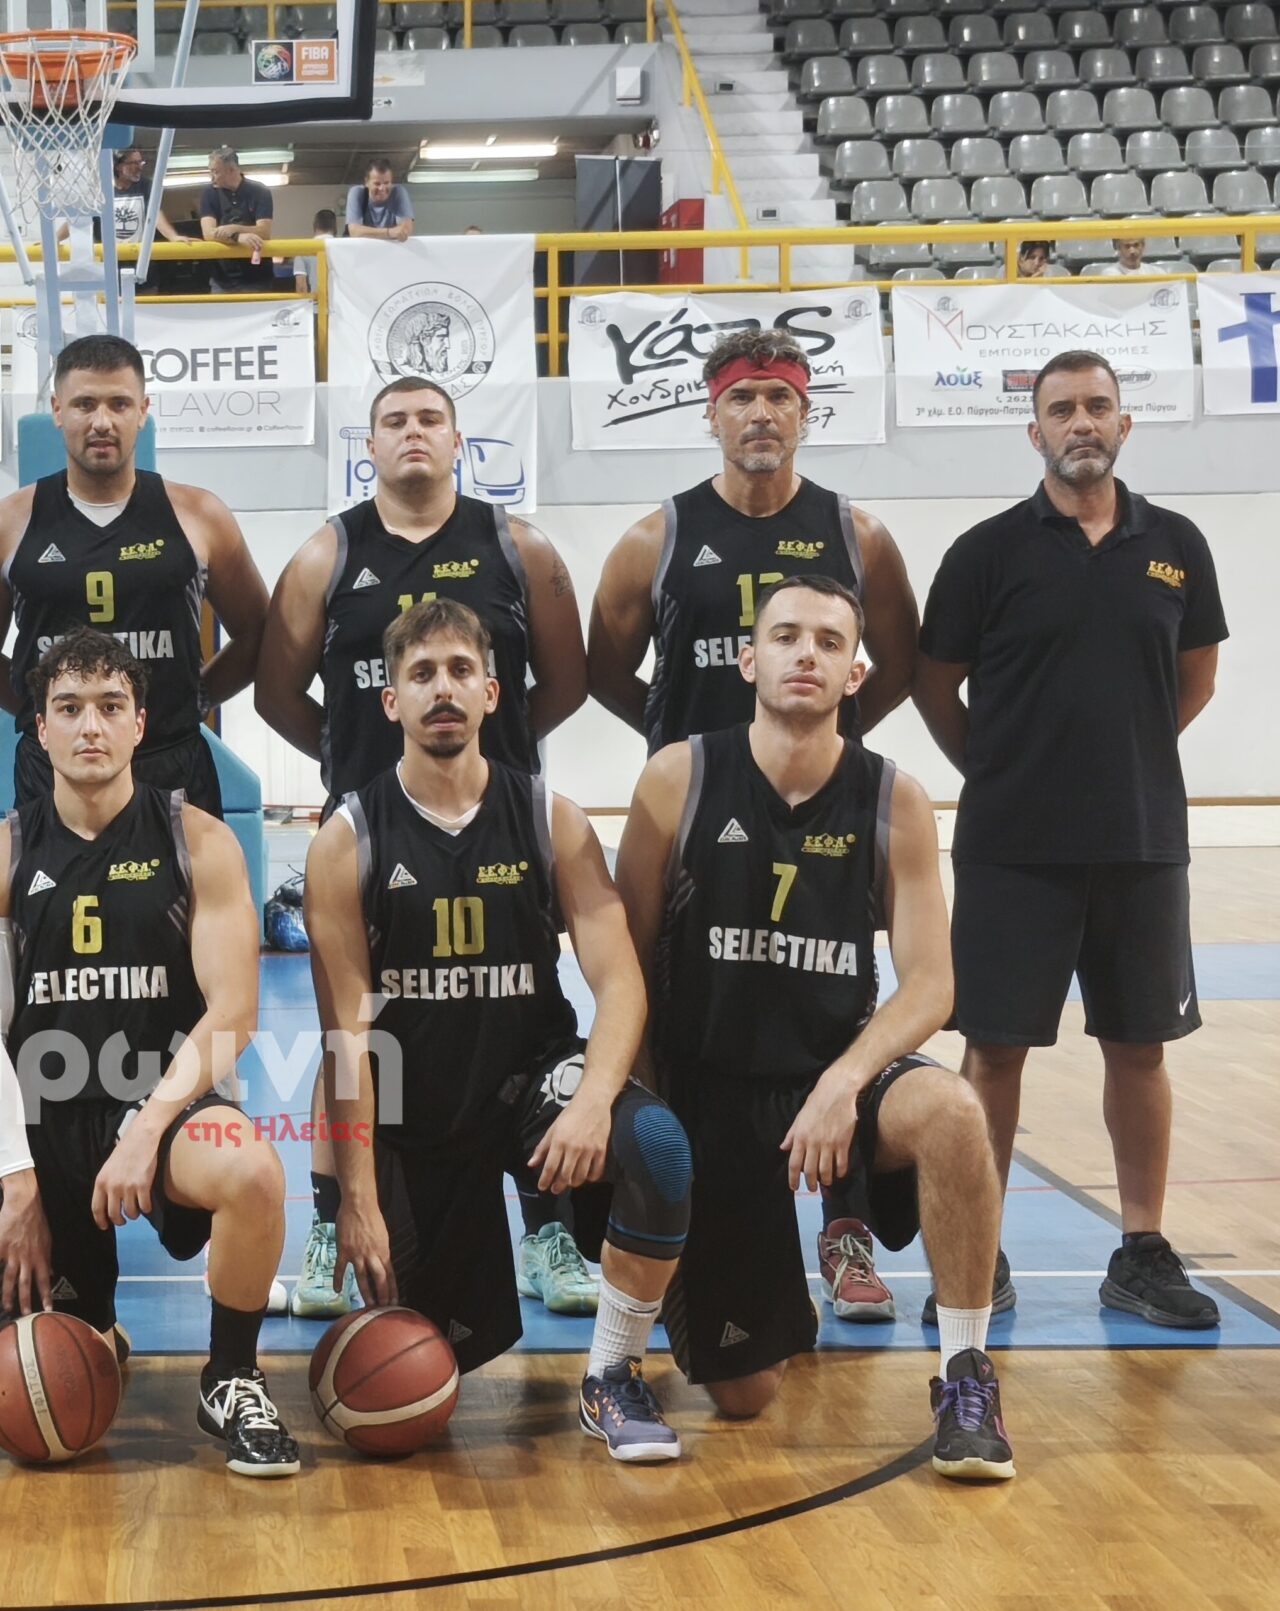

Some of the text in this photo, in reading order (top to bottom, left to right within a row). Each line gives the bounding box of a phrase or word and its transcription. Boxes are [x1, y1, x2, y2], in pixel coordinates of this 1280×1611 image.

[302, 46, 329, 60] FIBA
[607, 378, 708, 410] Χονδρικ
[85, 571, 115, 623] 9
[736, 572, 784, 627] 1
[37, 630, 175, 662] STIKA
[770, 861, 798, 922] 7
[72, 895, 102, 954] 6
[432, 896, 485, 958] 10
[709, 926, 858, 976] SELECTIKA
[380, 963, 536, 1000] SELECTIKA
